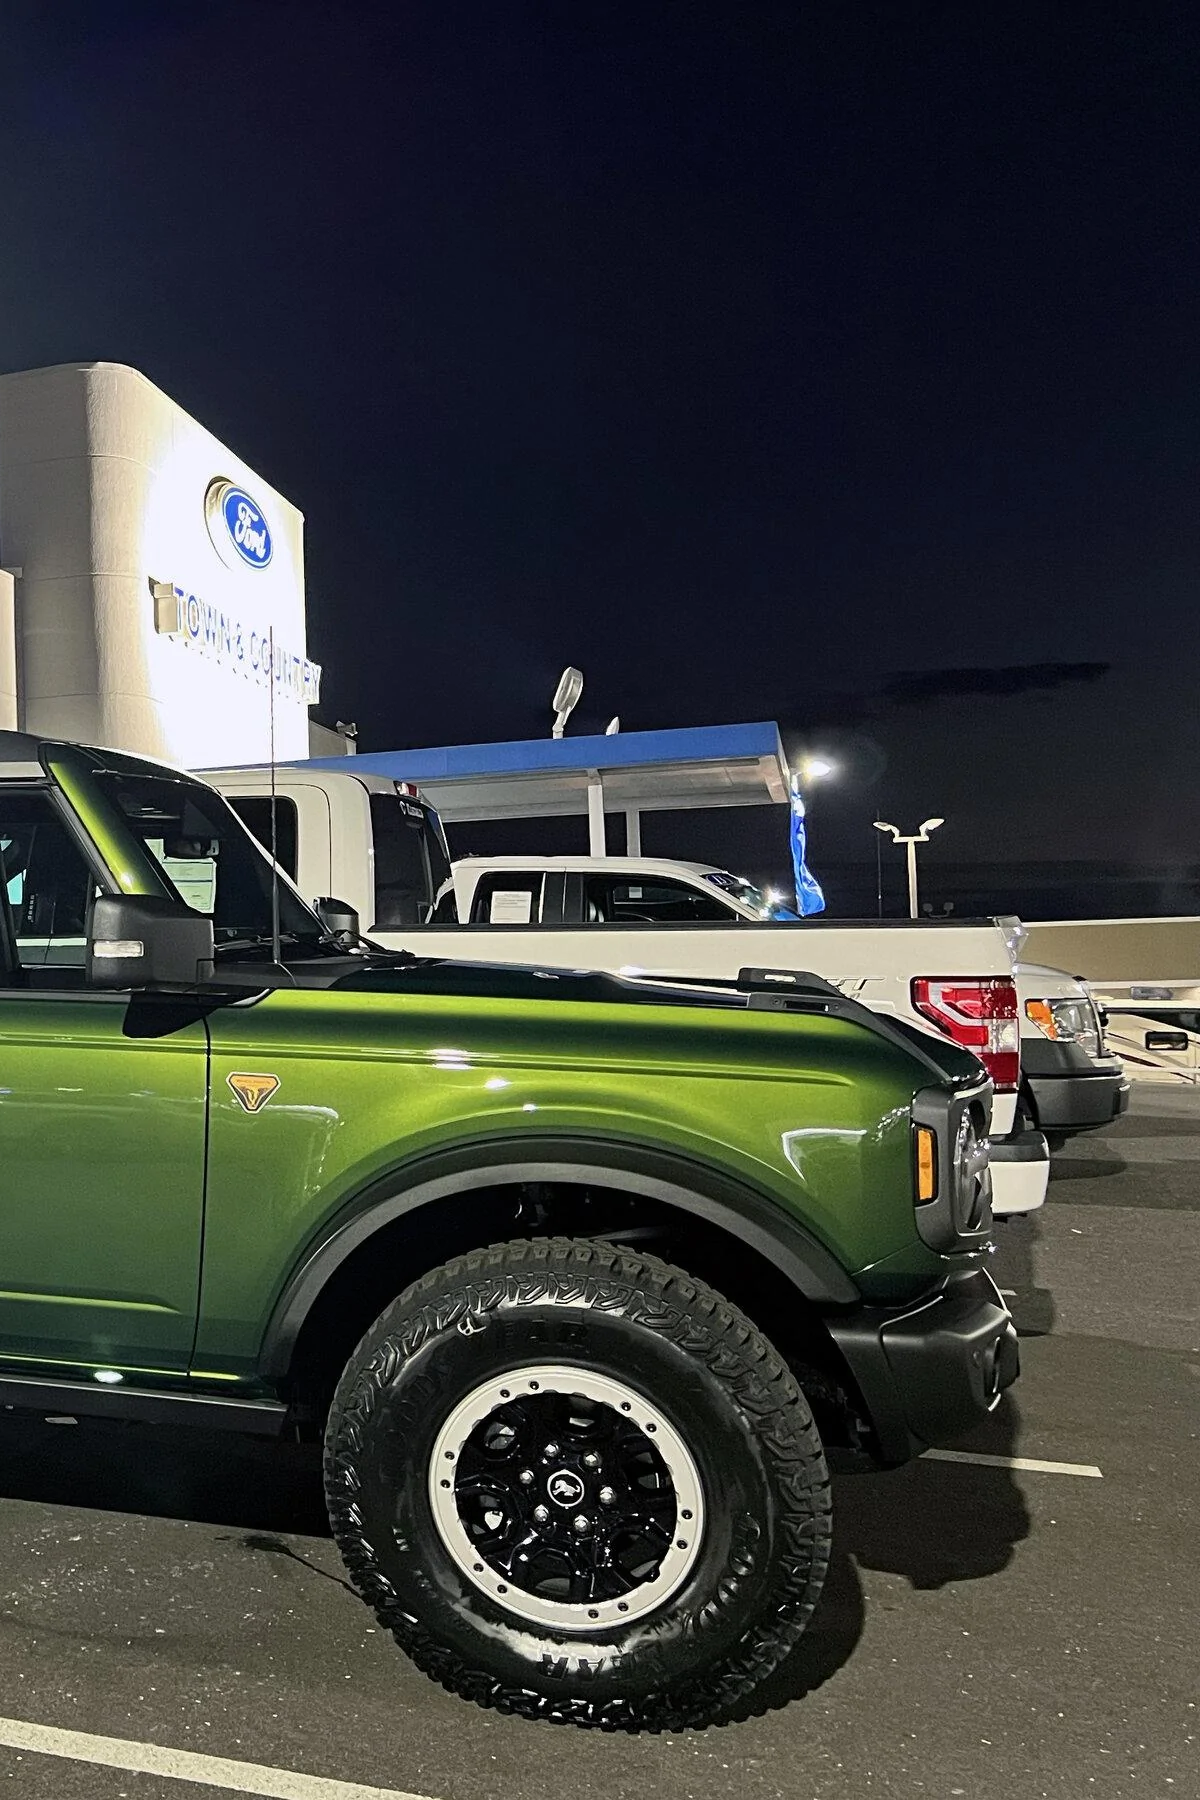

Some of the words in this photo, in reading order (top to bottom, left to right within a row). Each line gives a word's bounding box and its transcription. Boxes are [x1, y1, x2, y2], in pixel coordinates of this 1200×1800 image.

[234, 502, 267, 559] Ford
[174, 586, 231, 654] TOWN
[236, 622, 245, 660] &
